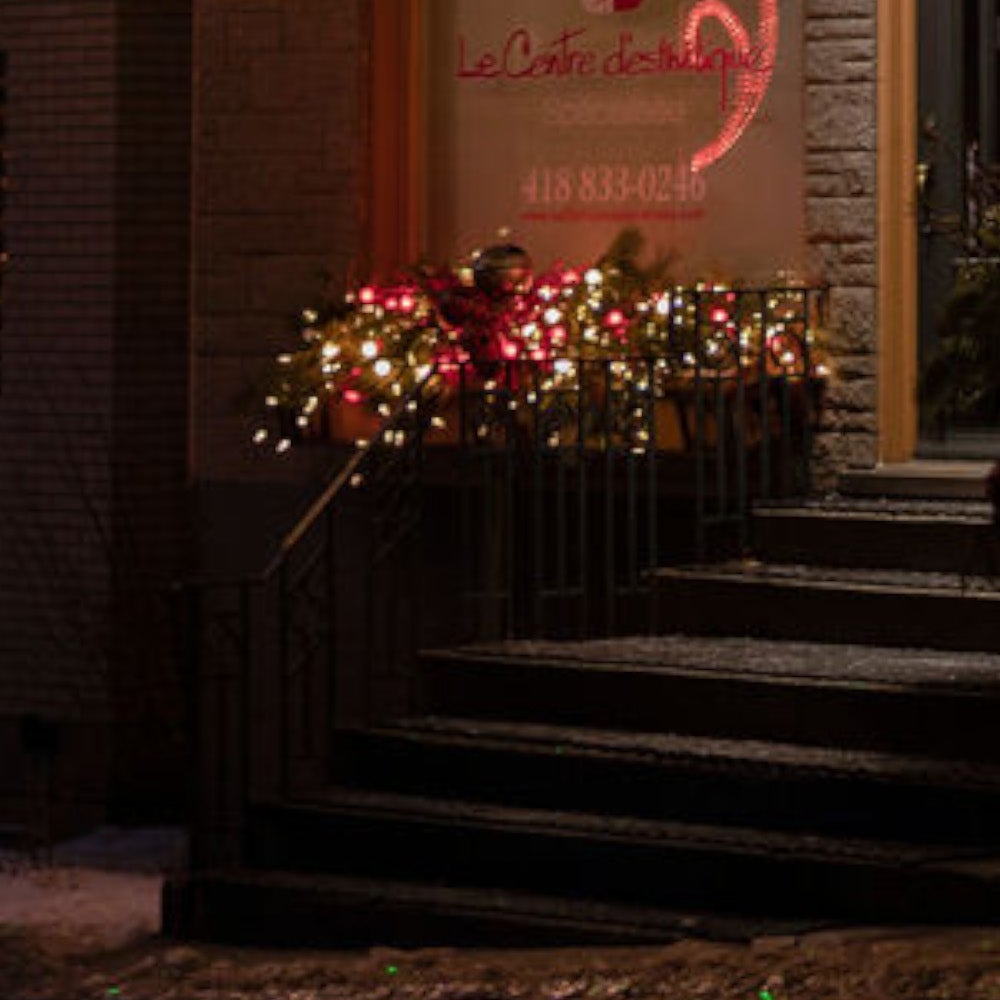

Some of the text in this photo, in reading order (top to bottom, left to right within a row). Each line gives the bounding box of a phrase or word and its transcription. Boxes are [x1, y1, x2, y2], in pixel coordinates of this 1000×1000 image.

[456, 35, 498, 78] Le
[502, 27, 597, 78] Centre
[521, 166, 572, 204] 418
